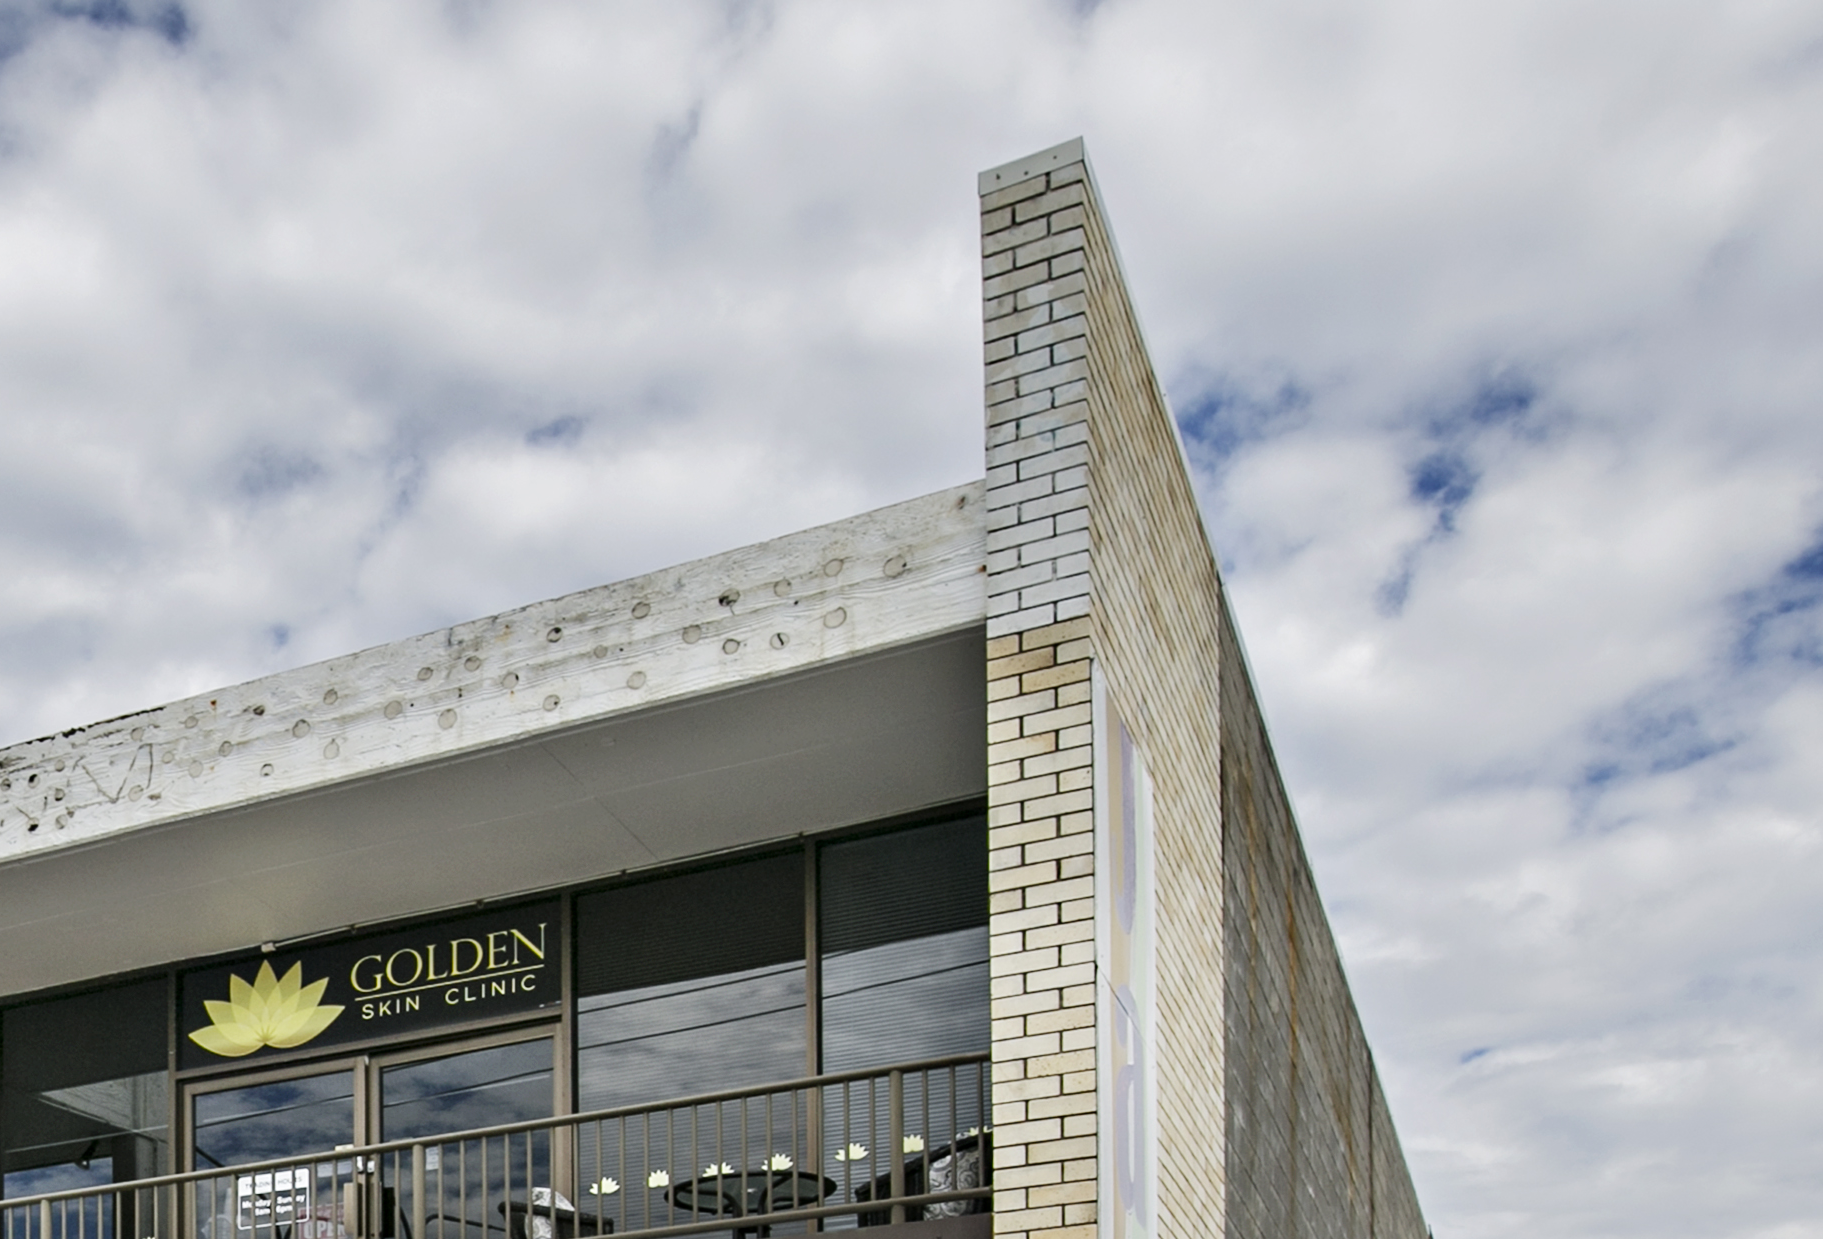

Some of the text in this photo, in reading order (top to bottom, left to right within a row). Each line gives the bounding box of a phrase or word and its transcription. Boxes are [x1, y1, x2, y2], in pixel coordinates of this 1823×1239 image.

[350, 923, 547, 994] GOLDEN
[362, 974, 537, 1020] SKIN CLINIC
